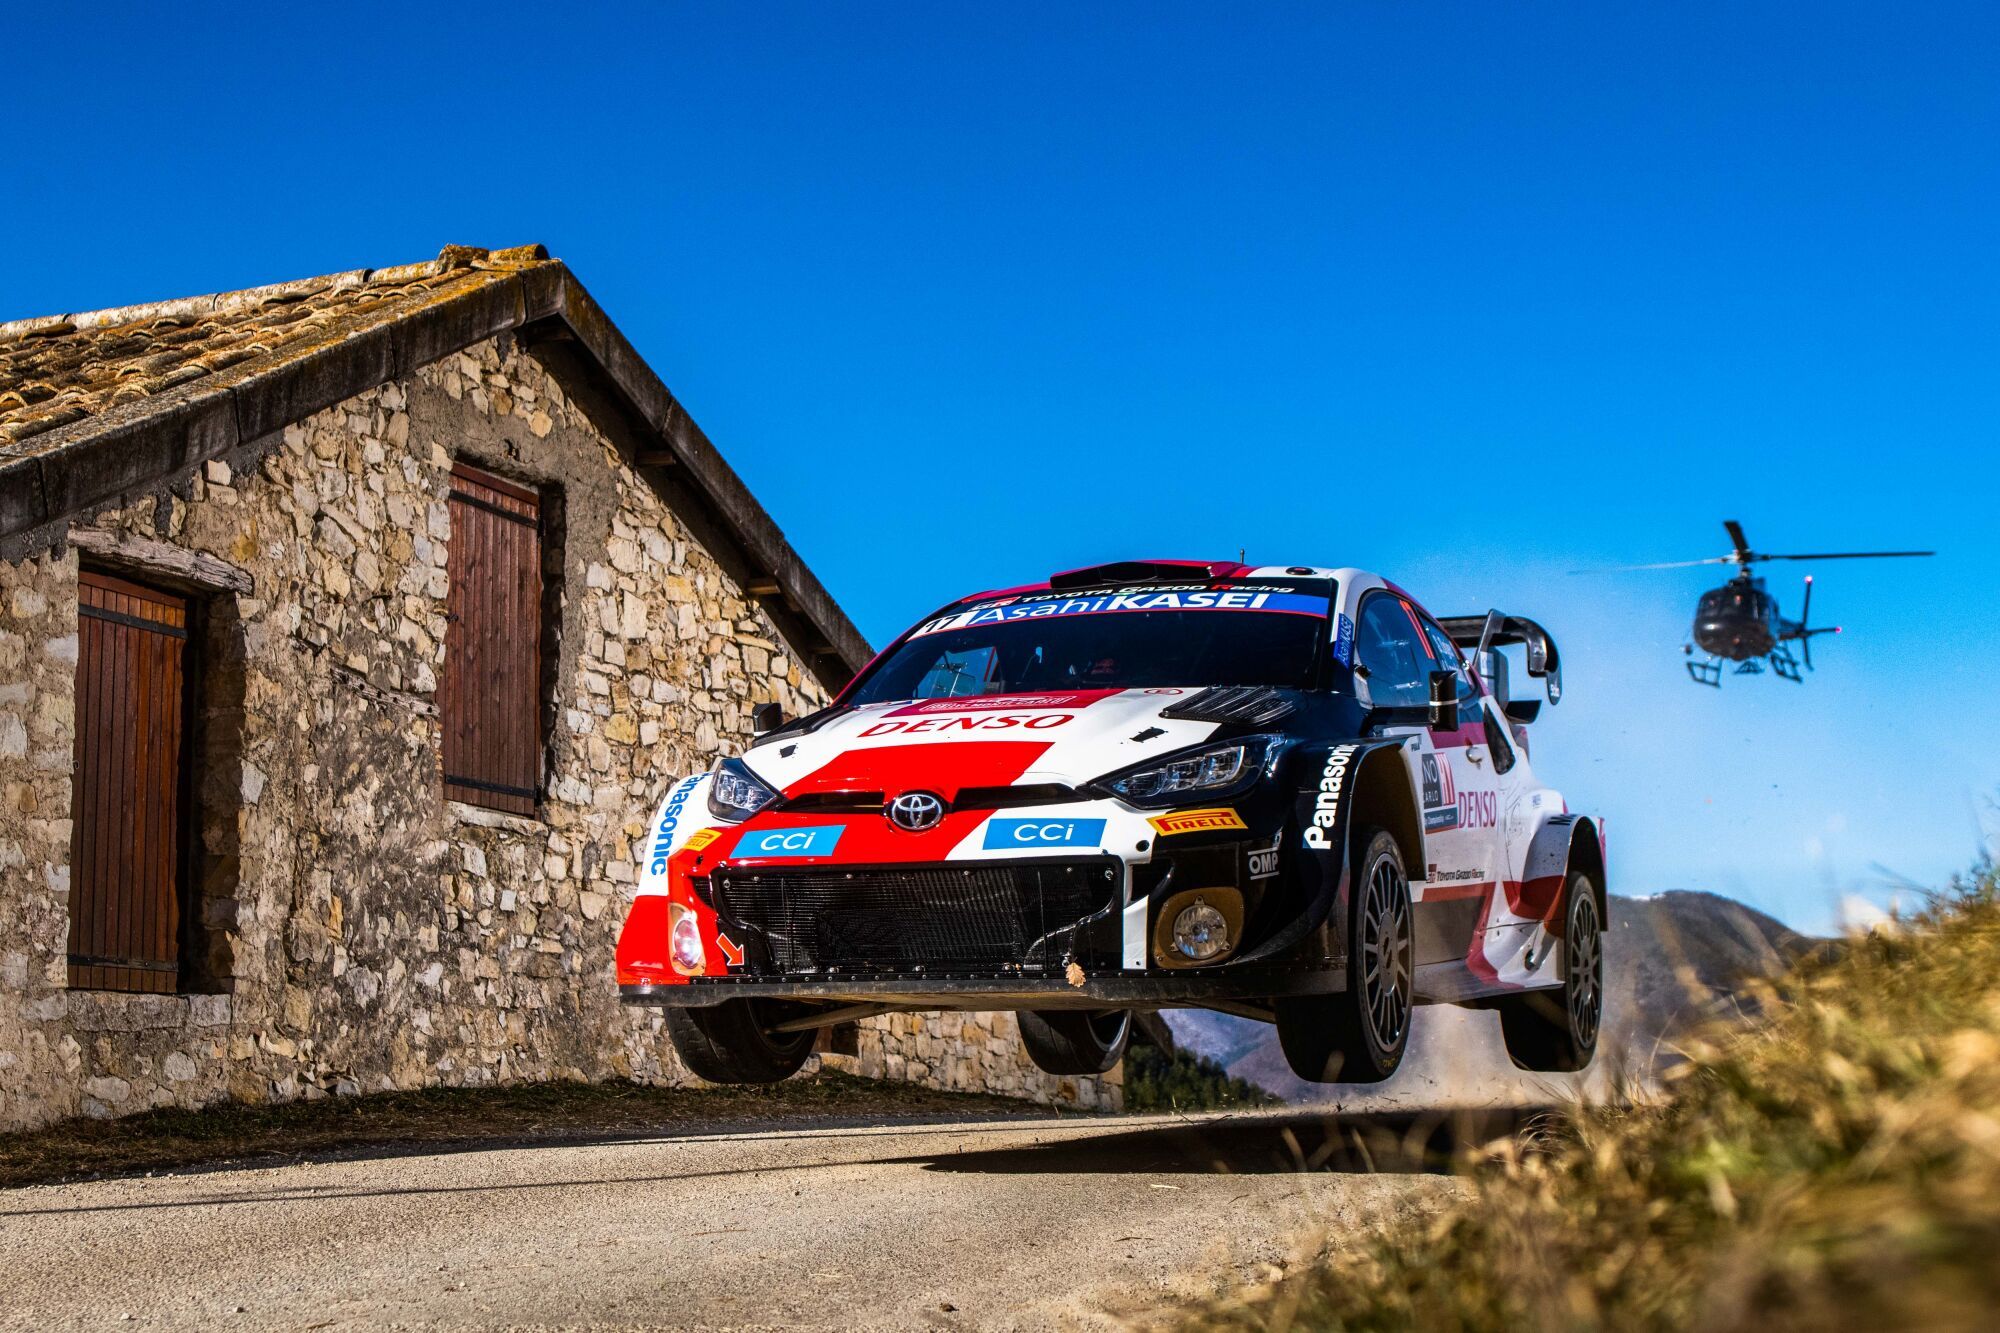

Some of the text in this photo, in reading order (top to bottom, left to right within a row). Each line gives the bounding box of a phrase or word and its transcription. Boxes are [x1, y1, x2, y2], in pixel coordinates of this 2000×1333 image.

[1022, 588, 1113, 602] TOYOTA
[1117, 584, 1206, 595] GAZOO
[1211, 584, 1295, 593] Racing
[857, 714, 1074, 738] DENSO
[1458, 790, 1496, 828] DENSO
[651, 772, 714, 876] anasonic
[1156, 811, 1238, 832] PIRELLI
[1249, 852, 1279, 873] OMP
